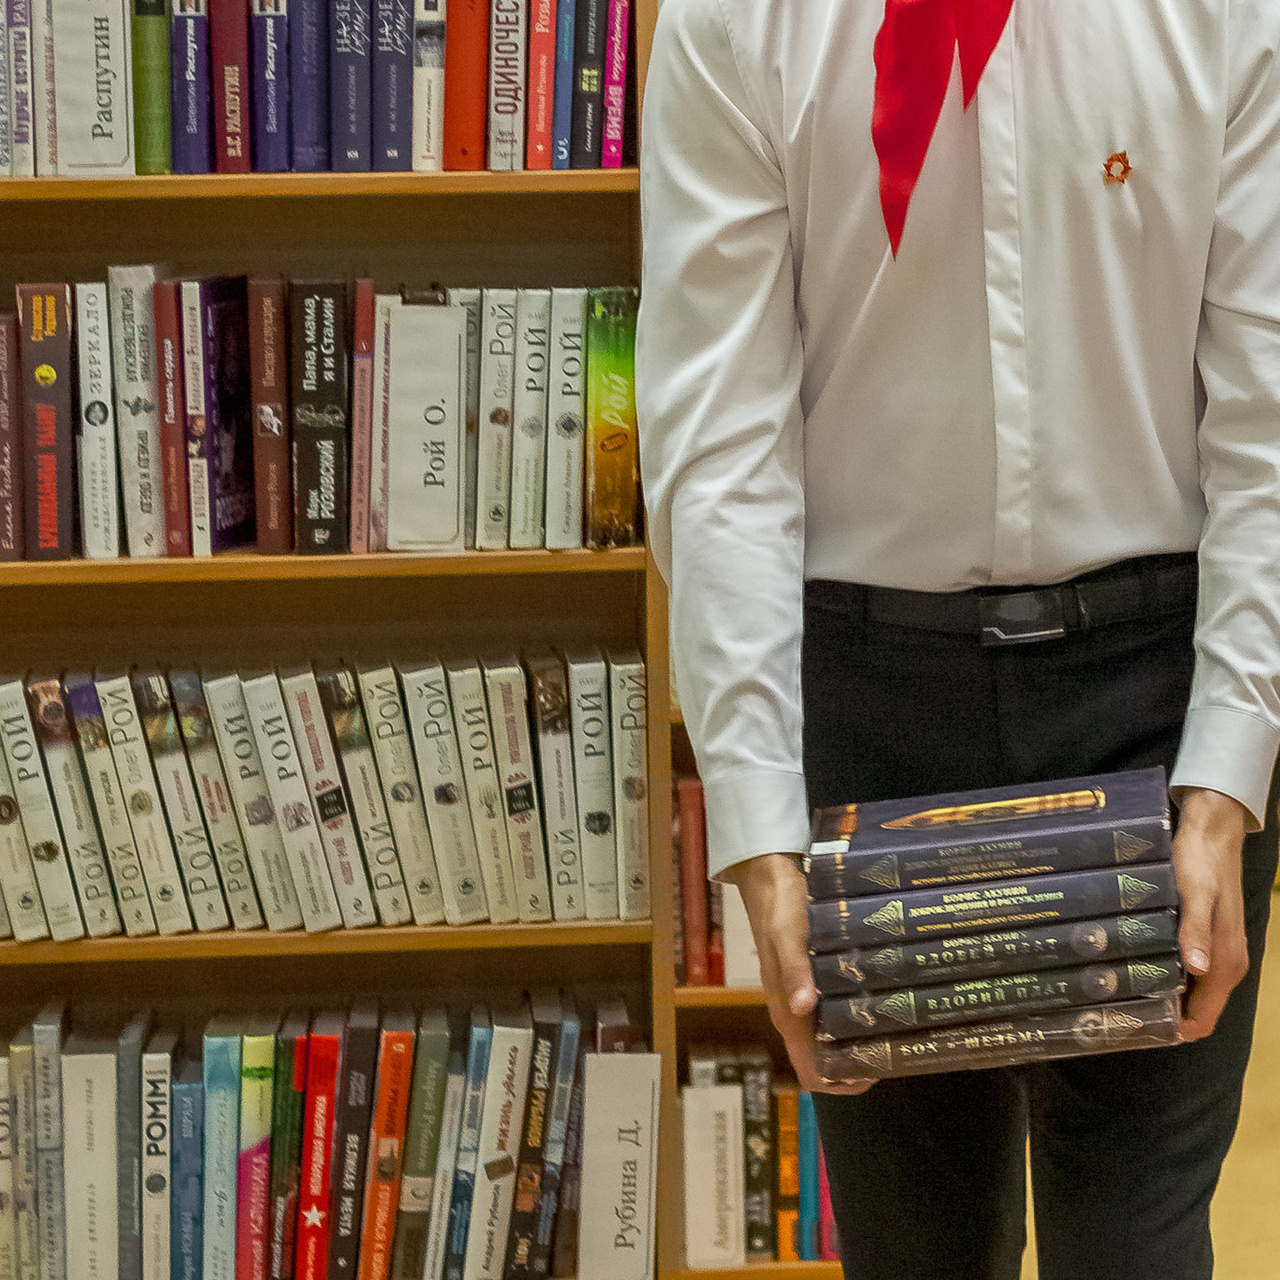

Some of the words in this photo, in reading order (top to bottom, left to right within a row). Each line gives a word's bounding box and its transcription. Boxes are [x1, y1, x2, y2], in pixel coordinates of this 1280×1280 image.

[89, 15, 118, 140] Распутин
[185, 18, 200, 81] Распутин
[265, 17, 279, 80] Распутин
[223, 65, 240, 133] РАСПУТИН
[605, 84, 622, 139] ВРЕМЯ
[85, 292, 103, 394] ЗЕРКАЛО
[302, 293, 320, 344] мама,
[320, 296, 335, 354] Сталин
[488, 303, 514, 356] Рой
[302, 346, 319, 391] Папа,
[323, 357, 335, 368] и
[323, 370, 335, 381] я
[522, 327, 546, 392] РОЙ
[557, 331, 582, 397] РОЙ
[422, 397, 445, 426] О.
[599, 371, 630, 429] Рой
[316, 439, 335, 519] РОЗОВСКИЙ
[422, 440, 446, 488] Рой
[307, 489, 320, 519] Марк
[102, 688, 138, 746] Рой
[368, 681, 405, 739] Рой
[417, 680, 451, 738] Рой
[578, 691, 605, 758] РОЙ
[619, 673, 647, 732] Рой
[3, 713, 39, 782] РОЙ
[226, 714, 258, 780] РОЙ
[262, 714, 297, 781] РОЙ
[462, 706, 492, 771] РОЙ
[75, 842, 108, 900] Рой
[111, 843, 142, 902] Рой
[178, 827, 215, 894] Рой
[219, 840, 247, 893] Рой
[364, 821, 400, 890] Рой
[554, 829, 578, 886] Рой
[145, 1078, 166, 1157] РОММ
[526, 1089, 546, 1148] РУБАНОВ
[617, 1119, 642, 1146] Д.
[342, 1134, 359, 1190] ВЕЛИКАЯ
[338, 1196, 354, 1236] МЕЧТА
[613, 1158, 643, 1250] Рубина
